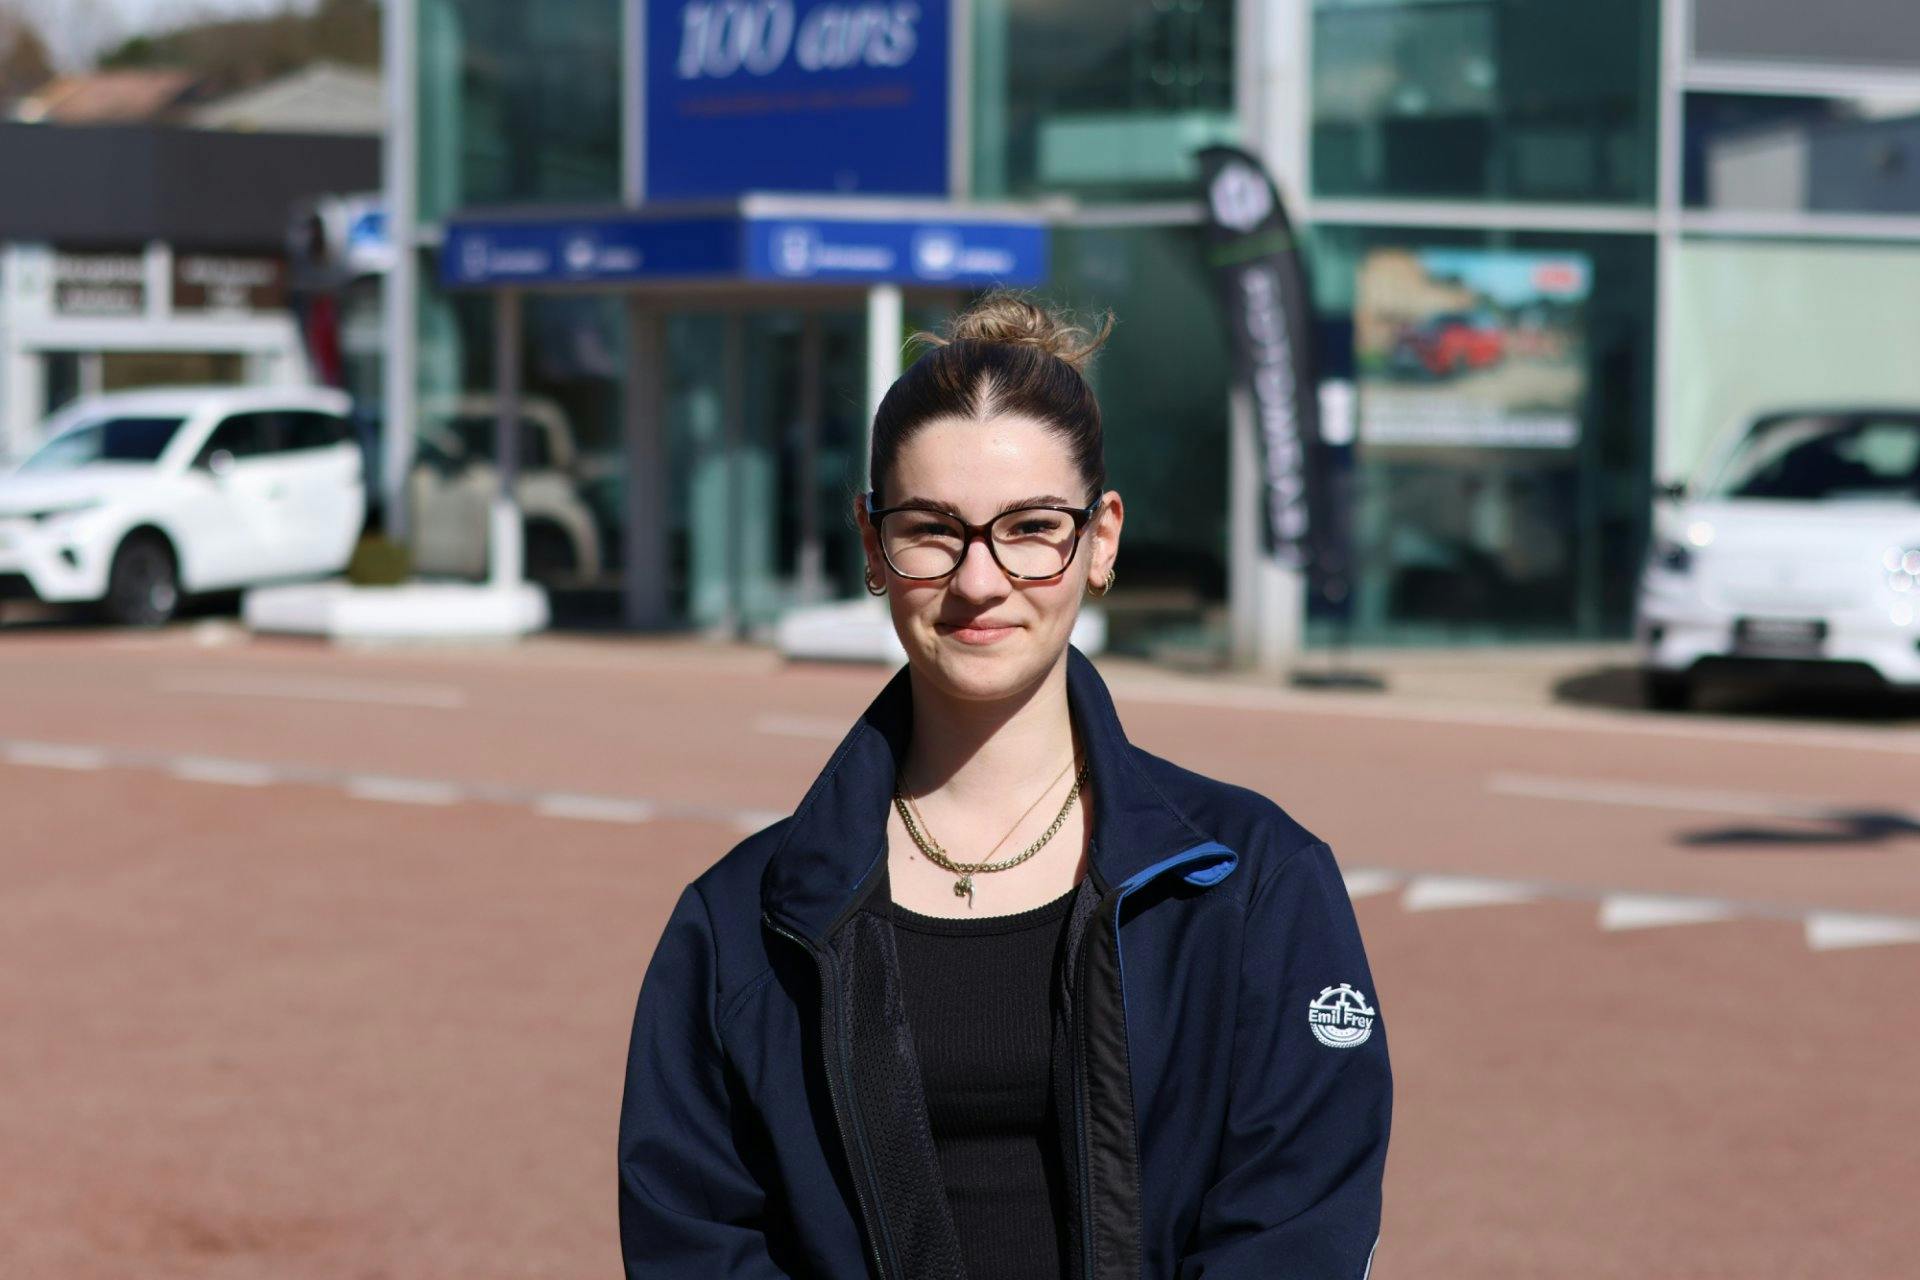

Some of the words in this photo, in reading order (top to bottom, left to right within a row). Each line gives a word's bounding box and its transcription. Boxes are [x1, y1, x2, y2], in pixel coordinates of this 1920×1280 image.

[678, 0, 795, 78] 100
[796, 1, 920, 71] ans
[1308, 1009, 1340, 1024] Emil
[1344, 1013, 1373, 1030] Frey
